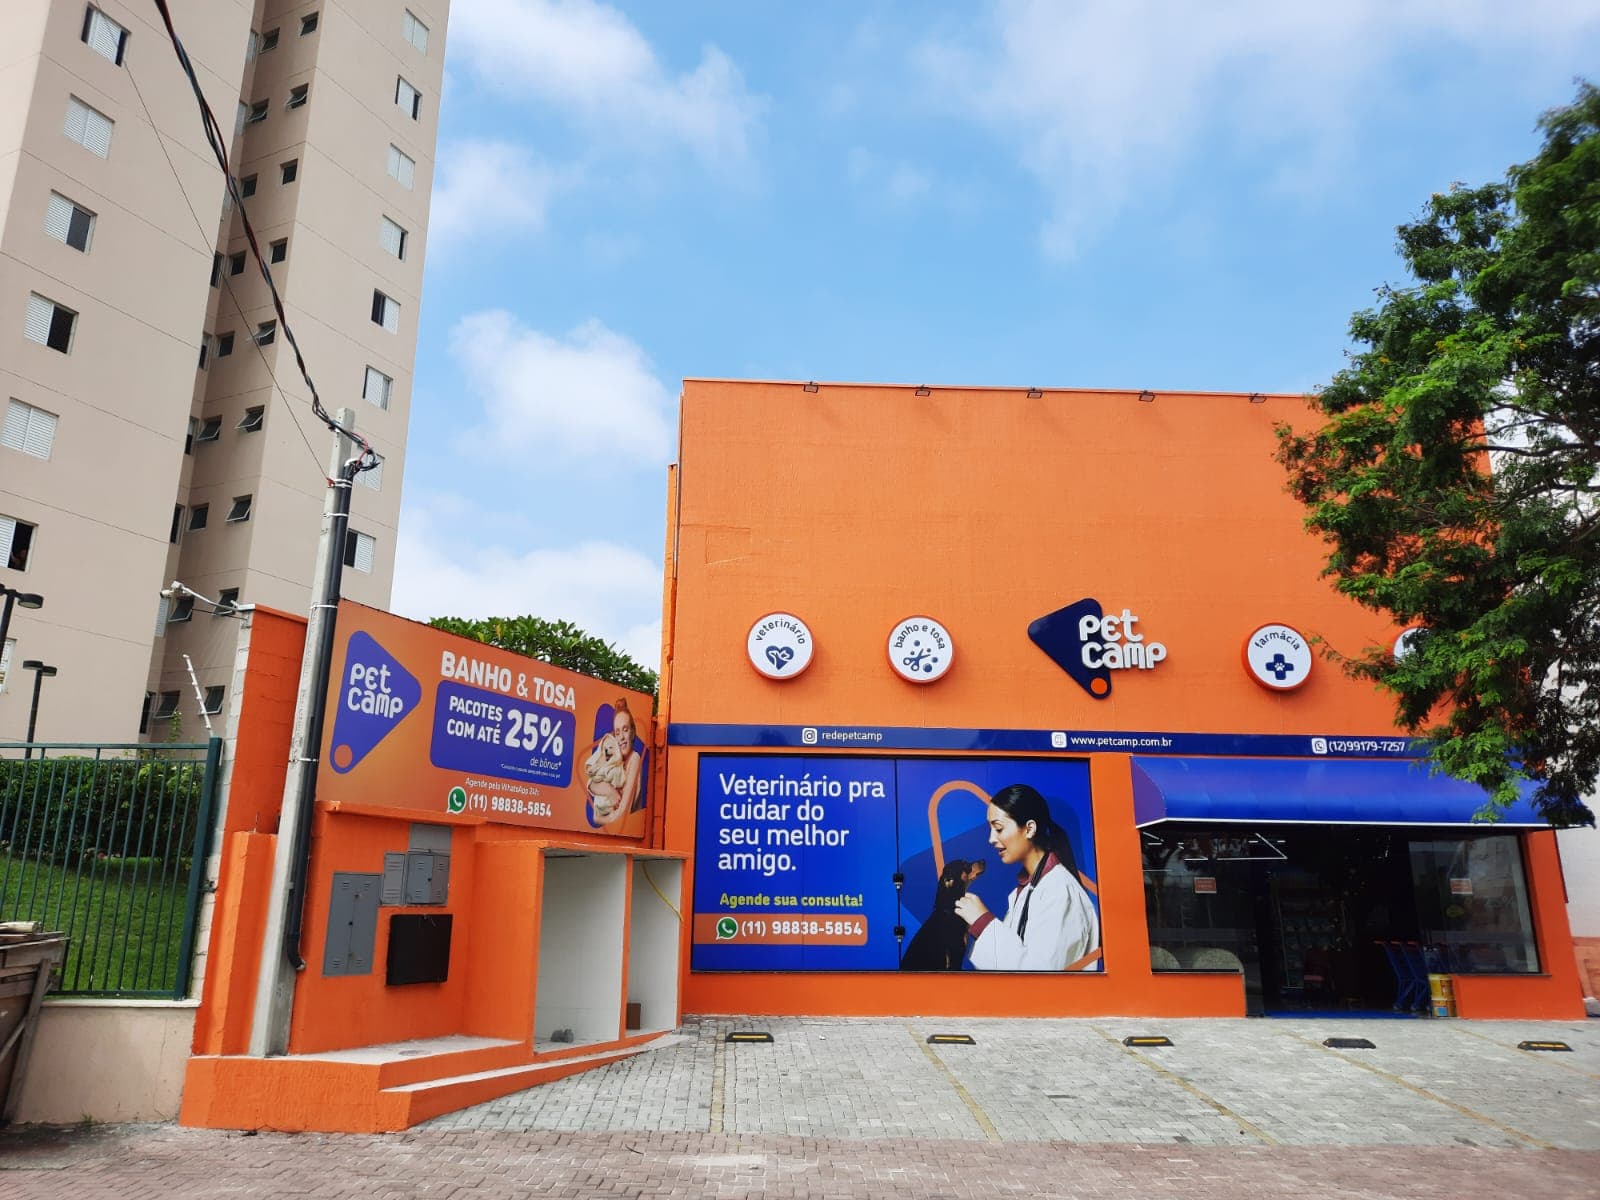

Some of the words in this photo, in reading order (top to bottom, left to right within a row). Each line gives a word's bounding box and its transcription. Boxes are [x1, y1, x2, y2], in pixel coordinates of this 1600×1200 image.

[754, 618, 806, 644] veterinário
[893, 623, 920, 650] banho
[922, 624, 930, 633] e
[930, 626, 946, 651] tosa
[1078, 609, 1144, 641] pet
[1254, 630, 1301, 651] farmácia
[1080, 641, 1167, 669] camp
[349, 663, 391, 694] pet
[440, 650, 512, 693] BANHO
[516, 672, 529, 698] &
[533, 676, 576, 710] TOSA
[347, 687, 404, 719] camp
[449, 695, 503, 722] PACOTES
[446, 718, 475, 739] COM
[478, 723, 501, 745] ATÉ
[504, 709, 564, 757] 25%
[821, 730, 883, 743] redepetcamp
[1070, 735, 1172, 748] www.petcamp.com.br
[529, 756, 539, 767] de
[465, 777, 488, 788] Agende
[501, 783, 529, 796] WhatsApp
[719, 772, 842, 798] Veterinário
[848, 780, 885, 802] pra
[468, 793, 488, 812] (11)
[491, 796, 552, 818] 98838-5854
[720, 798, 791, 821] cuidar
[797, 800, 825, 821] do
[718, 827, 759, 846] seu
[766, 823, 849, 846] melhor
[718, 848, 796, 877] amigo.
[719, 893, 771, 909] Agende
[773, 894, 798, 907] sua
[801, 893, 863, 907] consulta!
[741, 920, 767, 937] (11)
[771, 920, 863, 936] 98838-5854
